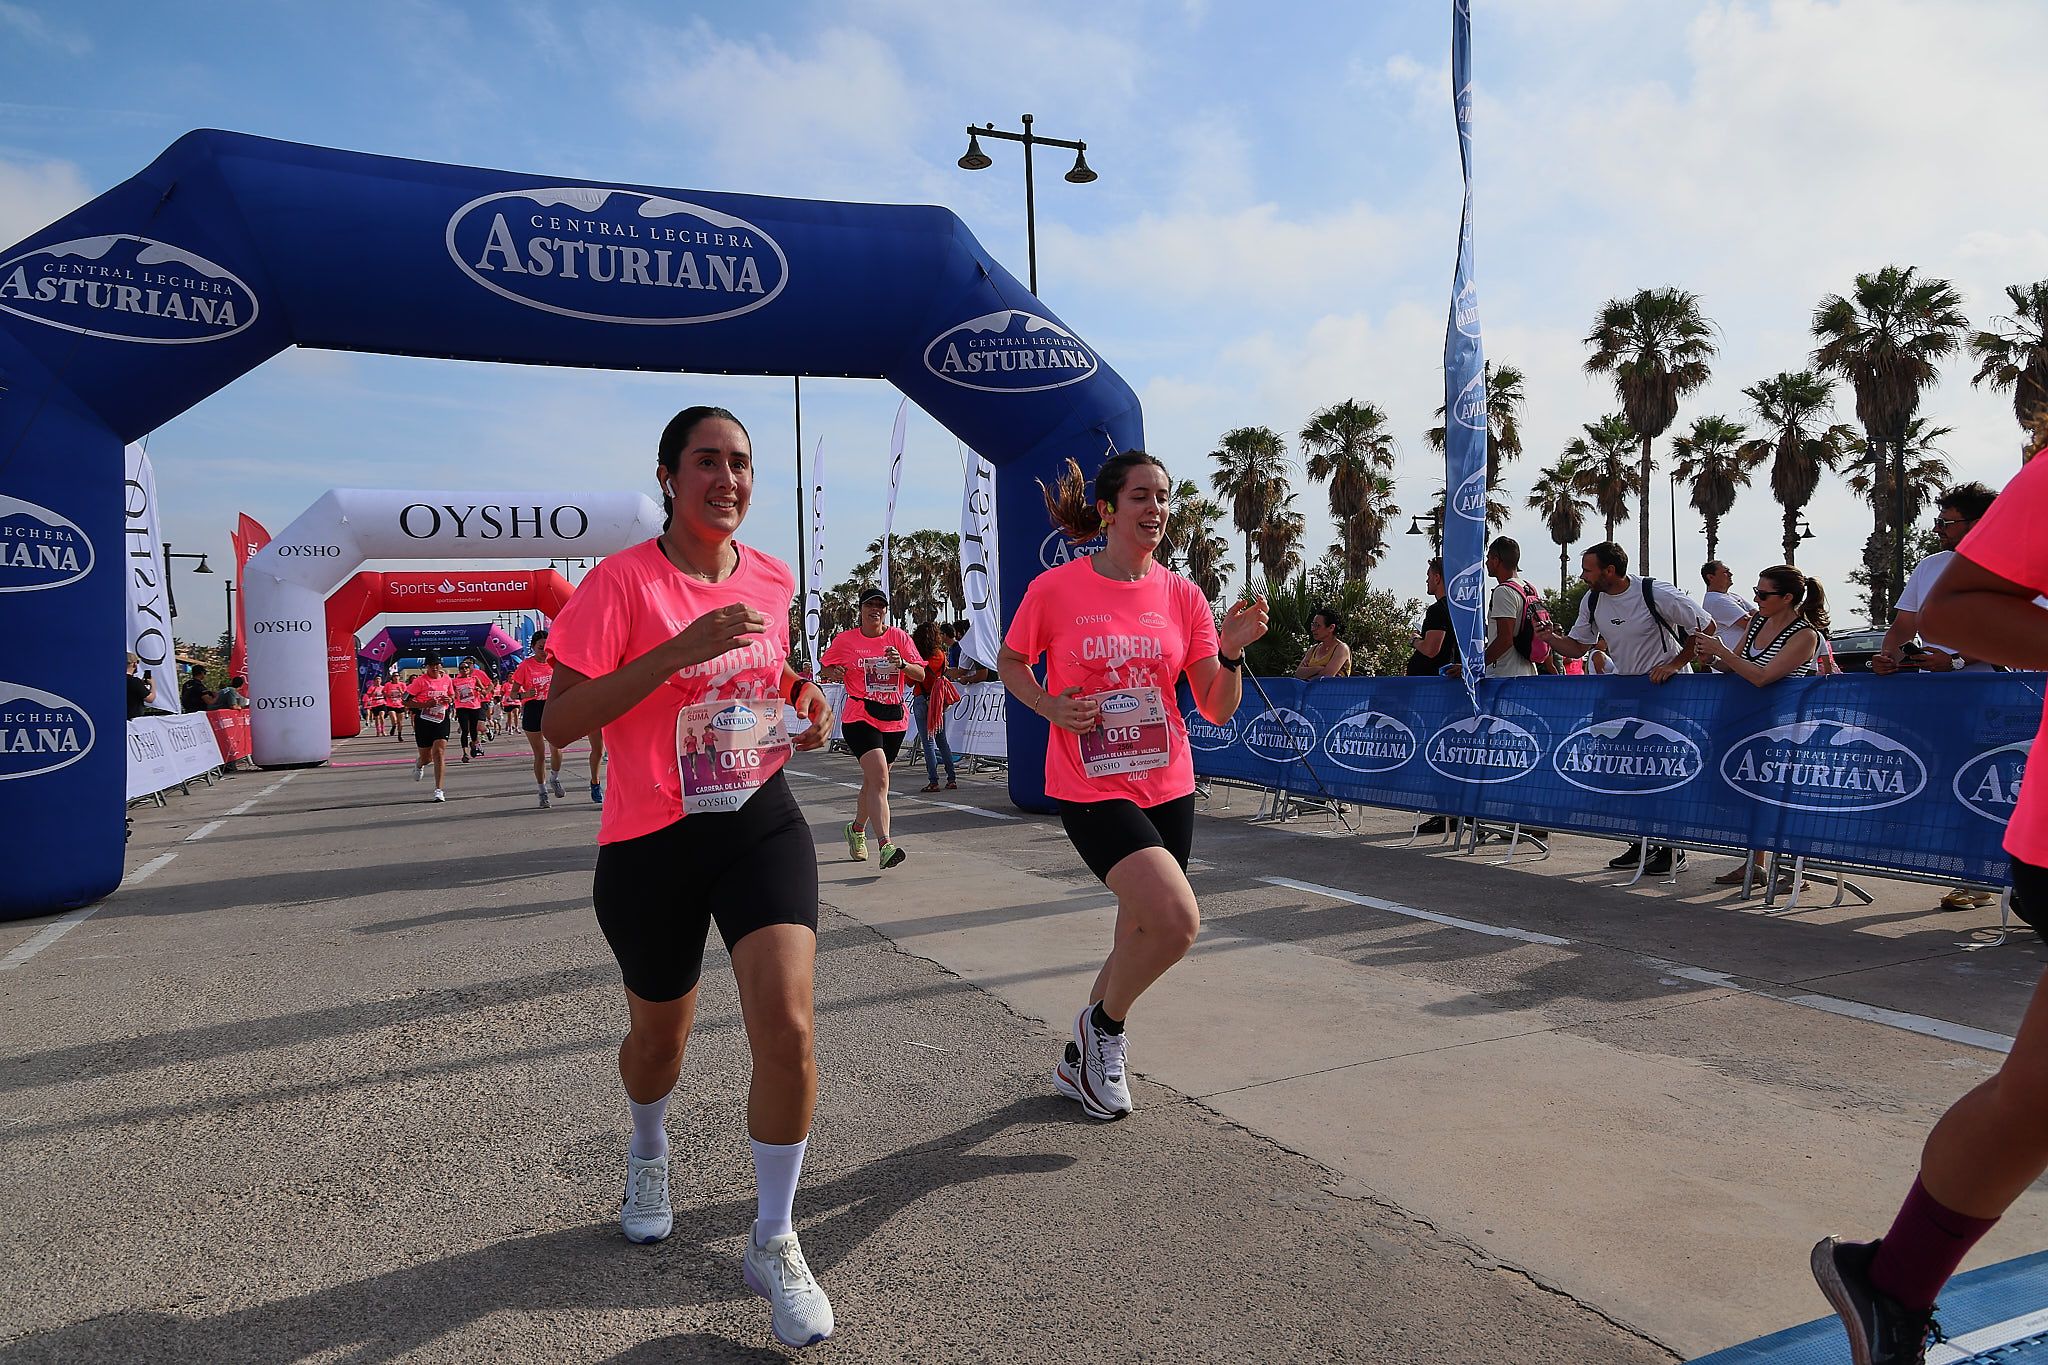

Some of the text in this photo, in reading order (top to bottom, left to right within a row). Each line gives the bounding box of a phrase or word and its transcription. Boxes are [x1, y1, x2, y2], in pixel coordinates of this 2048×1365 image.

[531, 214, 754, 249] CENTRAL LECHERA
[475, 213, 765, 294] ASTURIANA
[43, 263, 233, 296] CENTRAL LECHERA
[0, 265, 238, 327] ASTURIANA
[969, 337, 1079, 348] CENTRAL LECHERA
[939, 342, 1092, 373] ASTURIANA
[399, 503, 589, 540] OYSHO
[4, 526, 73, 542] ECHERA
[278, 545, 341, 558] OYSHO
[390, 580, 528, 597] Sports Santander
[254, 620, 312, 634] OYSHO
[1075, 613, 1112, 625] OYSHO
[1083, 635, 1162, 661] CARRERA
[257, 695, 315, 710] OYSHO
[953, 693, 1007, 722] OYSH
[1103, 702, 1138, 711] ASTURIANA
[4, 713, 74, 723] ECHERA
[687, 712, 709, 722] SUMA
[716, 716, 755, 727] ASTURIANA
[1106, 726, 1141, 742] 016
[1451, 737, 1527, 747] CENTRAL LECHERA
[1329, 731, 1407, 759] ASTURIANA
[1431, 737, 1529, 768] ASTURIANA
[1586, 743, 1687, 754] CENTRAL LECHERA
[720, 749, 760, 769] 016
[1090, 754, 1110, 762] CARRERA
[1561, 743, 1689, 777] ASTURIANA
[1765, 748, 1904, 765] CENTRAL LECHERA
[1093, 758, 1160, 773] OYSHO Santander
[1732, 748, 1907, 795] ASTURIANA
[695, 785, 724, 794] CARRERA
[698, 796, 738, 807] OYSHO
